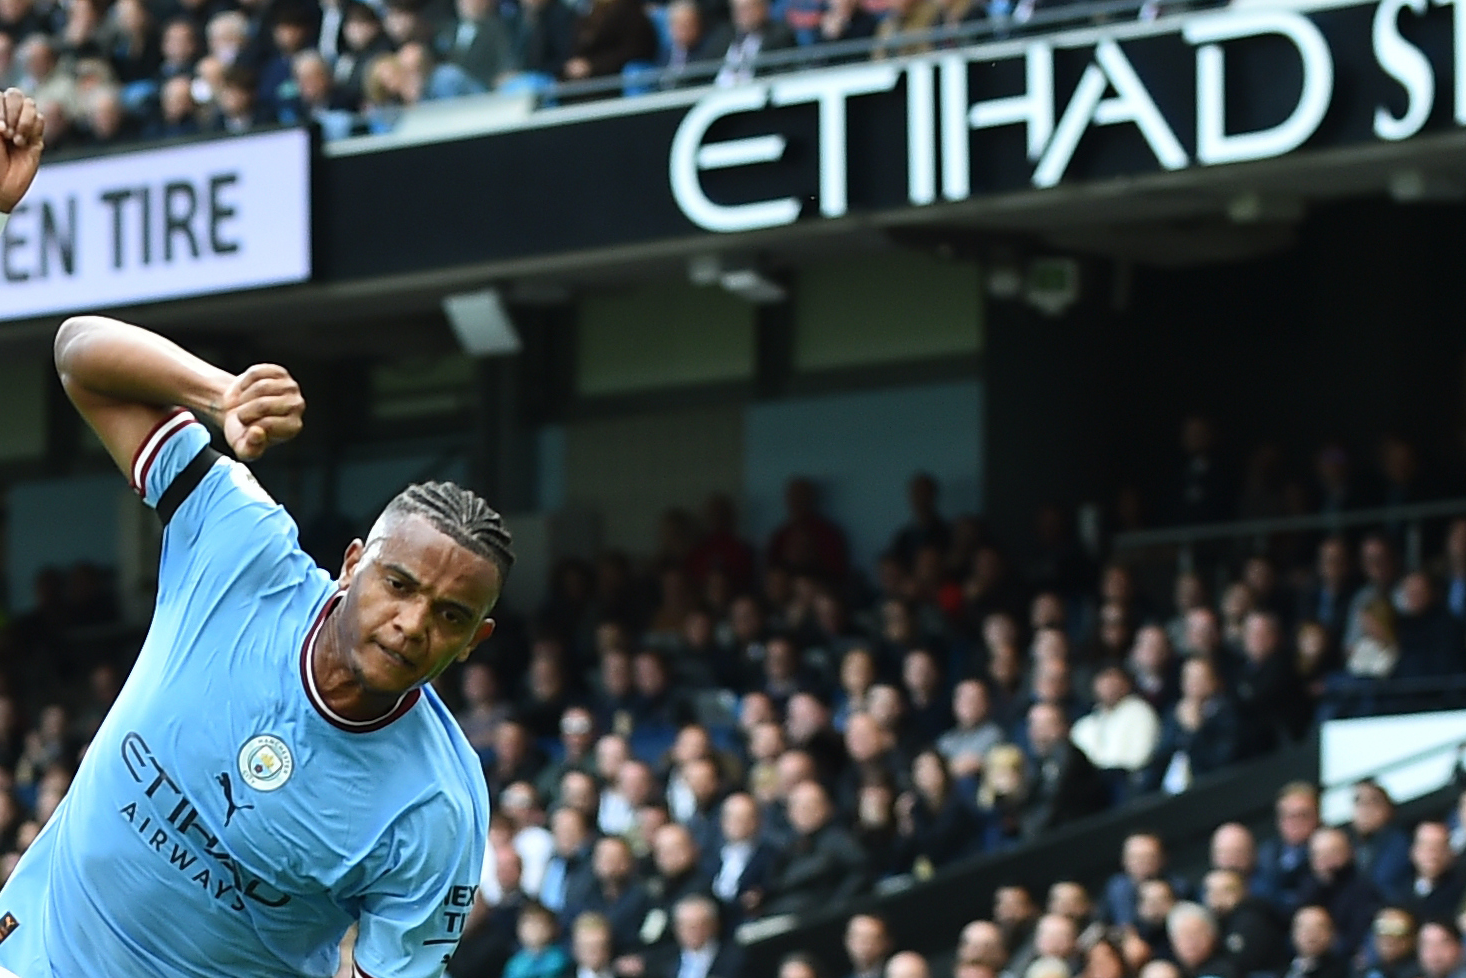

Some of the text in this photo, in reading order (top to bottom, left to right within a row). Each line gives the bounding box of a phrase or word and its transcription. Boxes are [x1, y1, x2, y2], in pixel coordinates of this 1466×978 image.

[670, 10, 1333, 232] ETIHAD
[101, 173, 238, 269] TIRE
[121, 731, 292, 907] ETIHAD
